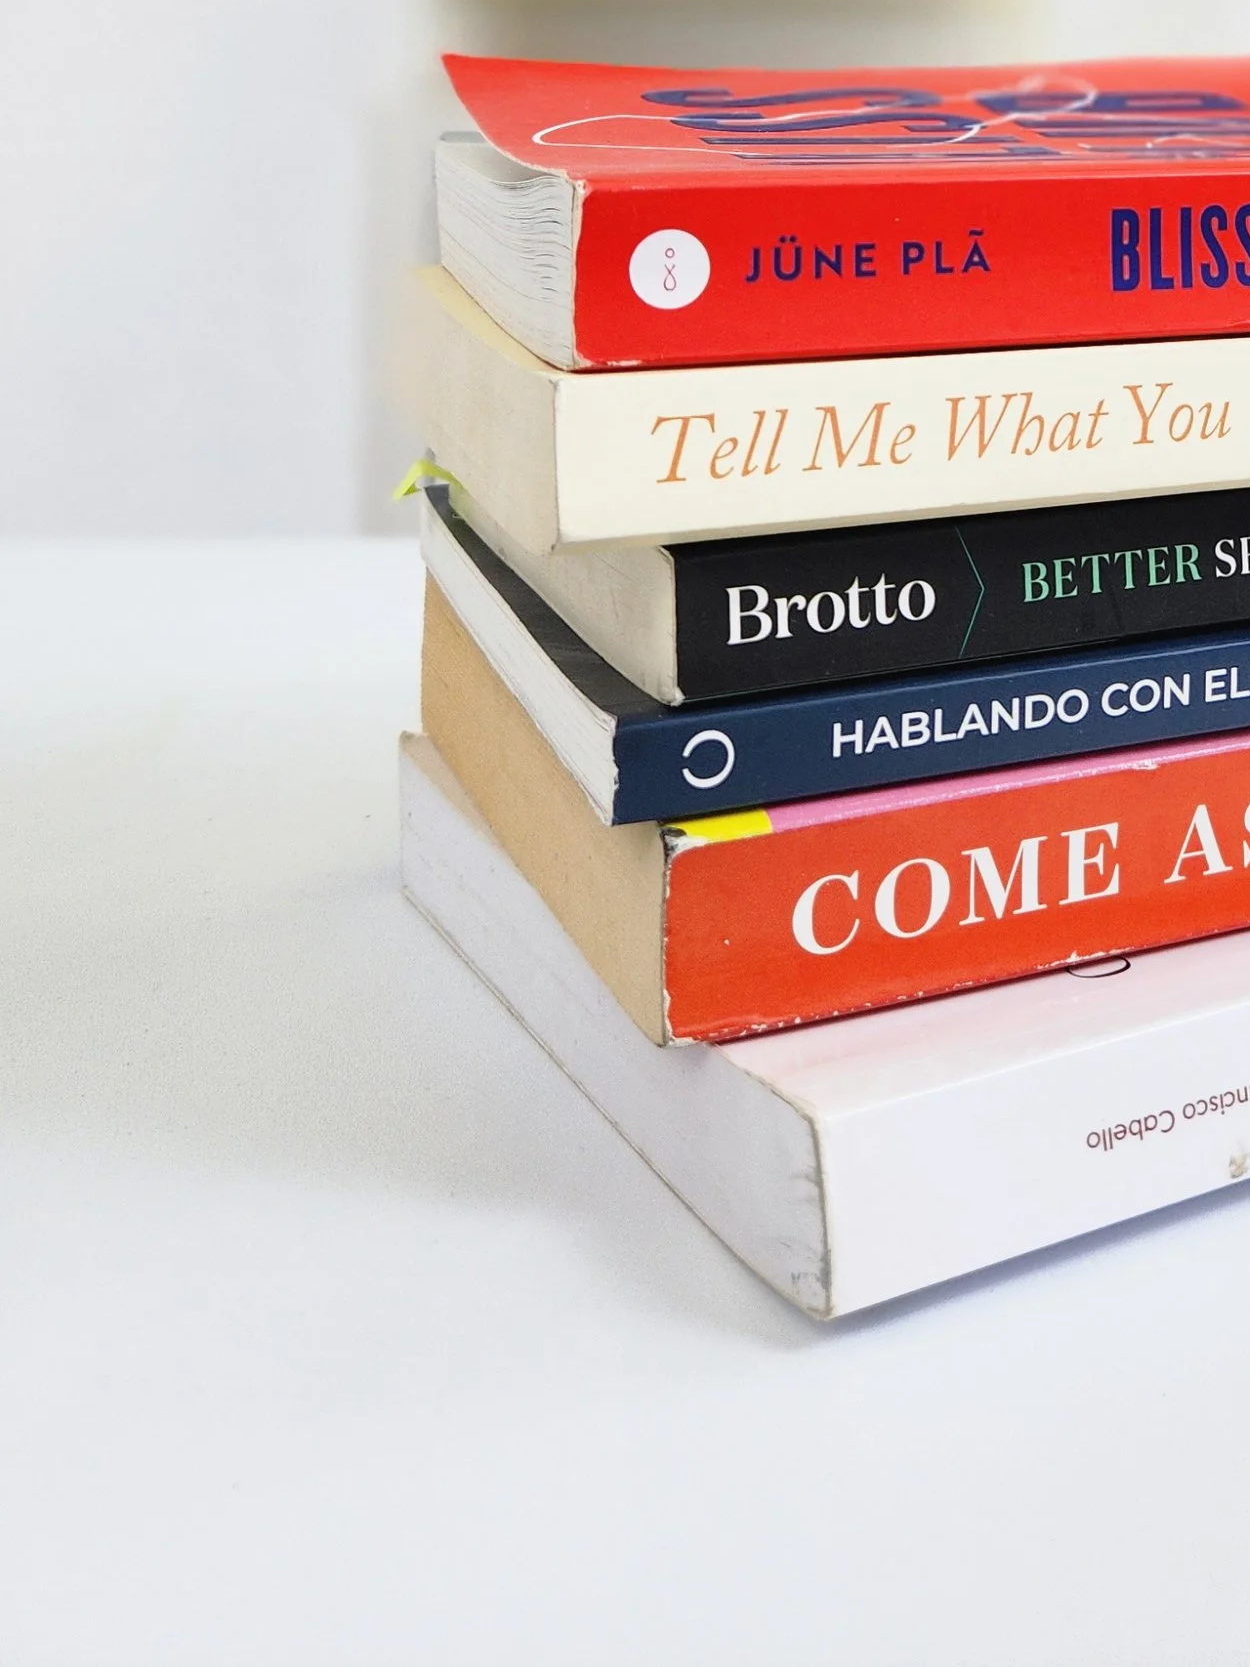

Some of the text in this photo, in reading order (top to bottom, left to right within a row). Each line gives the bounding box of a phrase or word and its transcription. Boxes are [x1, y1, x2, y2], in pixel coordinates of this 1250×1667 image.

[745, 229, 990, 283] JÜNE PLÃ
[651, 409, 788, 483] Tell
[802, 402, 916, 471] Me
[945, 392, 1109, 461] What
[1123, 383, 1231, 444] You
[1023, 545, 1202, 602] BETTER
[726, 574, 935, 645] Brotto
[833, 689, 1089, 757] HABLANDO
[1102, 674, 1190, 716] CON
[792, 822, 1119, 955] COME
[1086, 1109, 1176, 1151] Cabello
